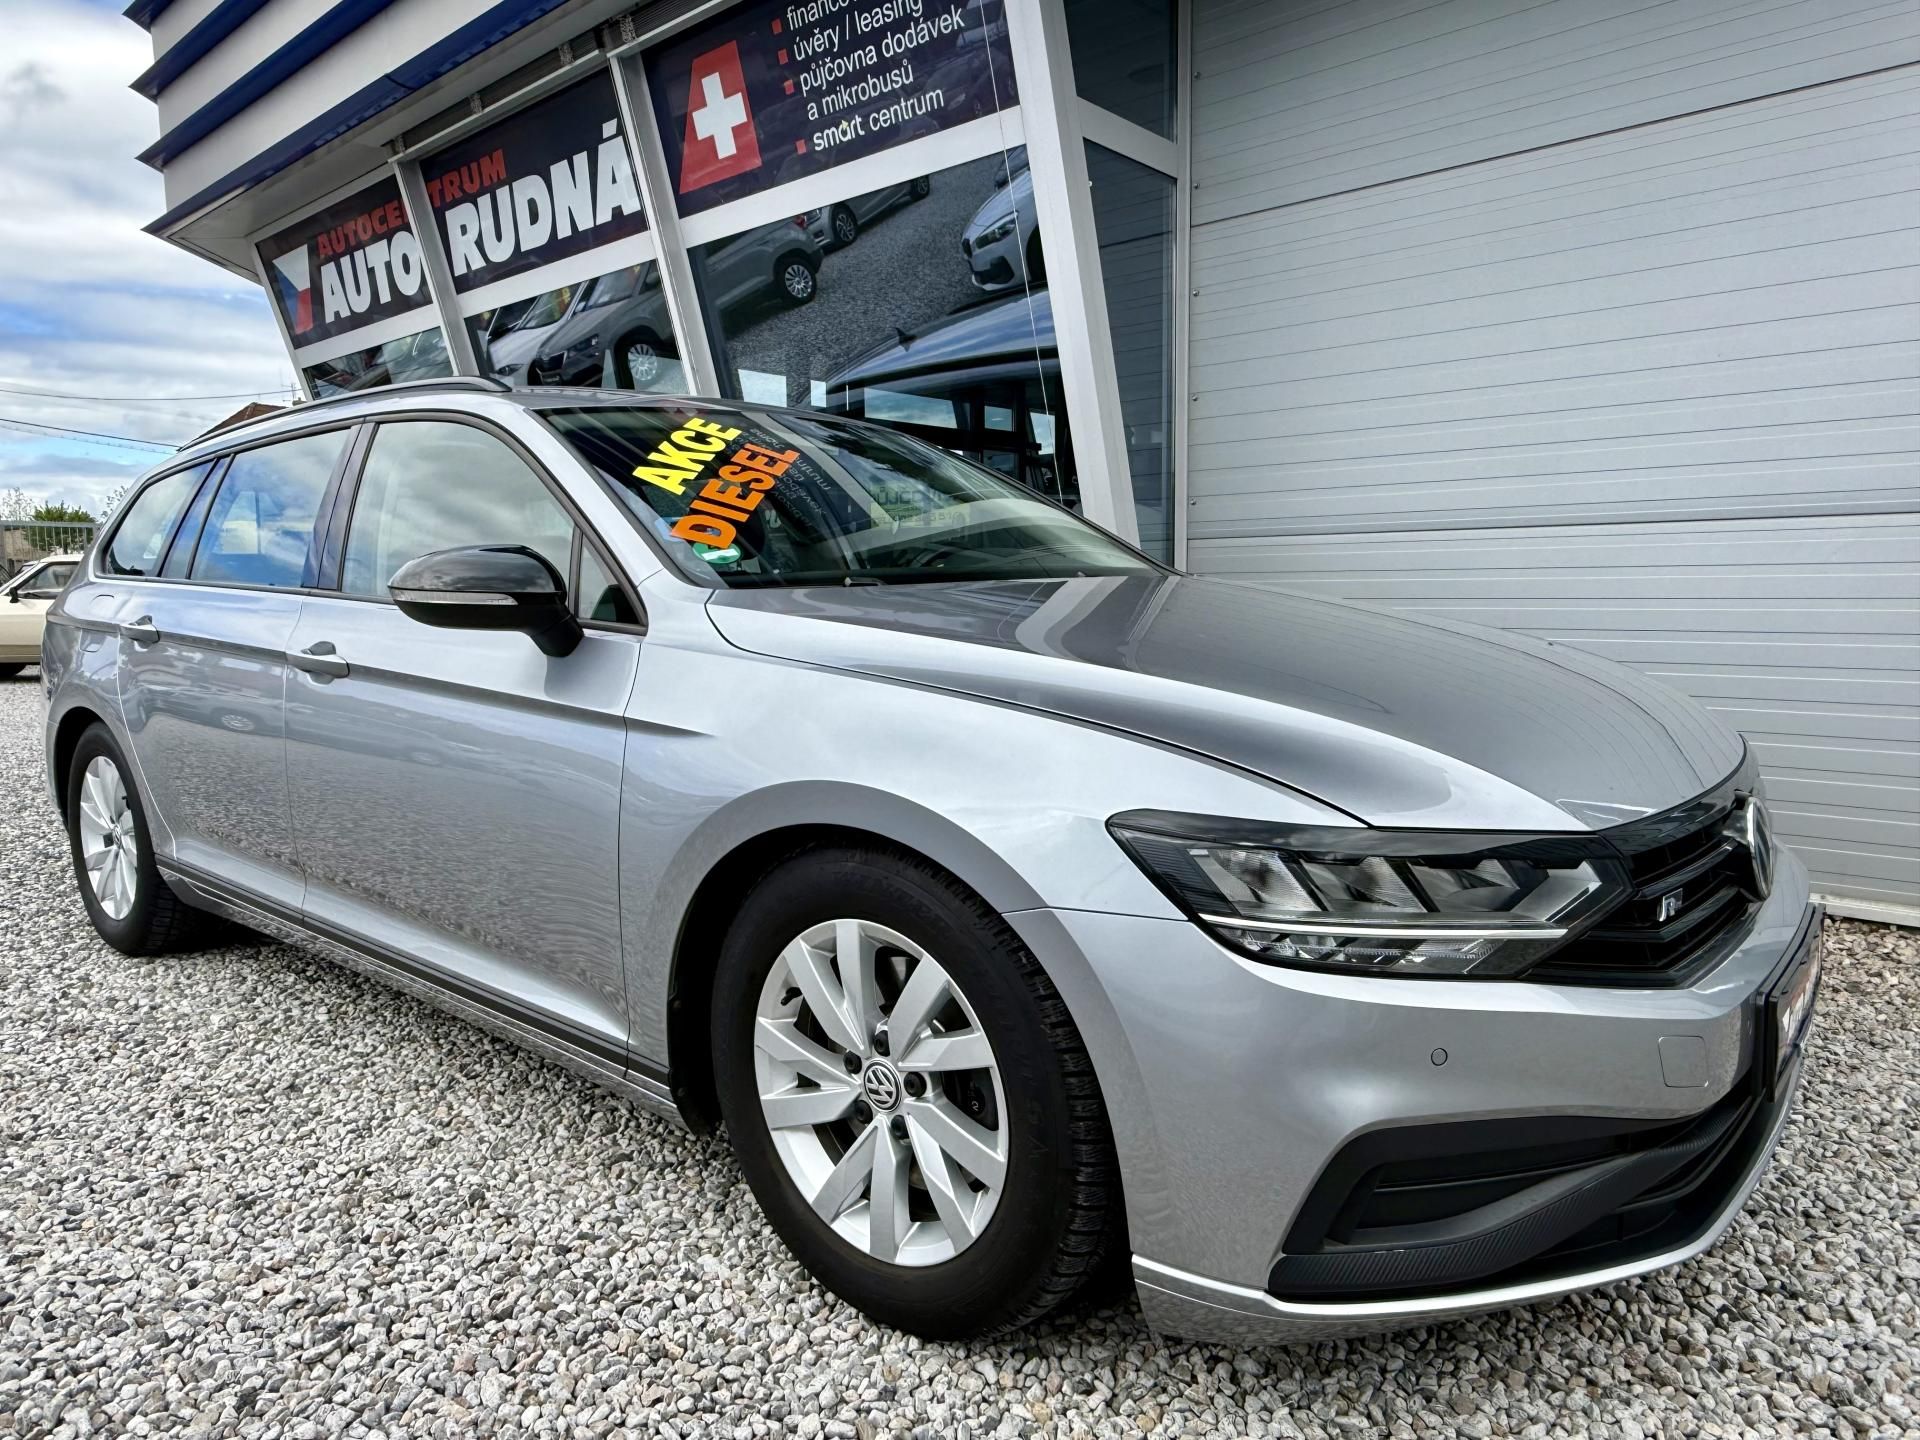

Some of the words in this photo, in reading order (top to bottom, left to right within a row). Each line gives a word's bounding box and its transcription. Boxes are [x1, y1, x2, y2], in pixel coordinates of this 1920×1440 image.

[793, 25, 839, 61] úvěry
[854, 0, 923, 35] leasing
[799, 45, 878, 97] půjčovna
[881, 4, 966, 58] dodávek
[807, 100, 819, 121] a
[822, 58, 914, 116] mikrobusů
[813, 115, 866, 151] smart
[869, 89, 945, 131] centrum
[320, 231, 424, 324] AUTO
[445, 119, 642, 276] RUDNÁ
[632, 417, 742, 495] AKCE
[671, 443, 801, 549] DIESEL
